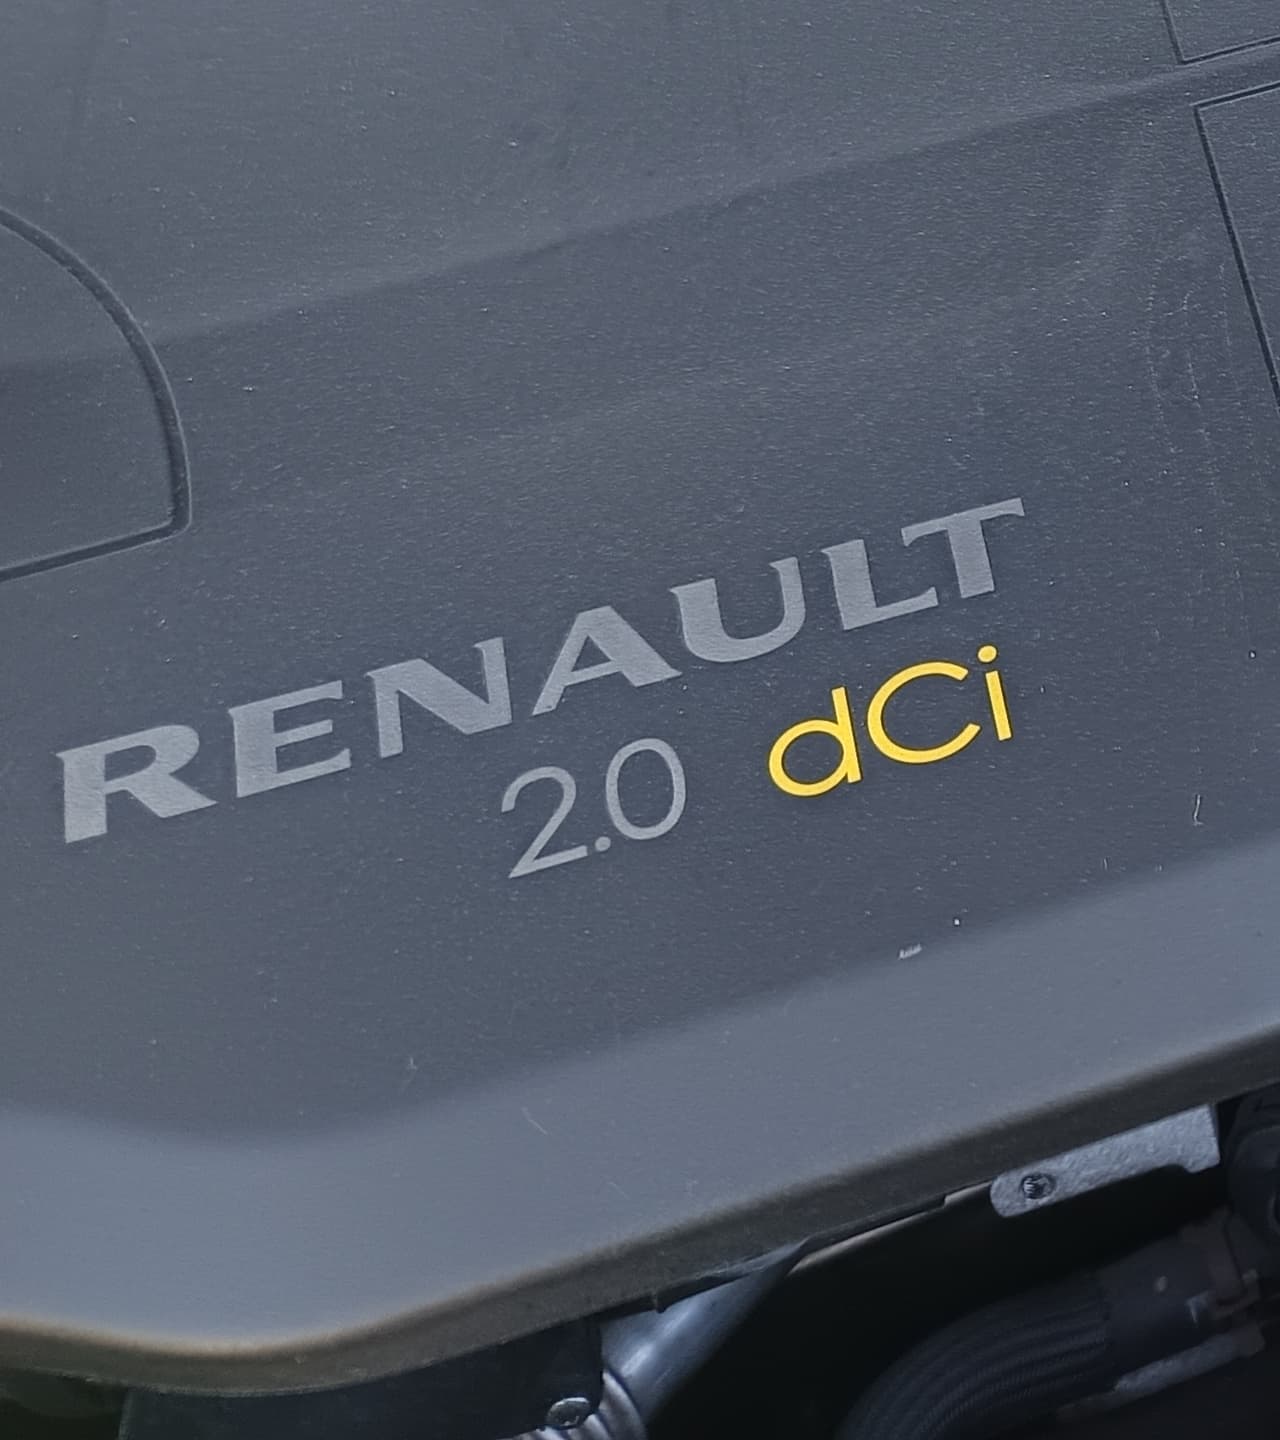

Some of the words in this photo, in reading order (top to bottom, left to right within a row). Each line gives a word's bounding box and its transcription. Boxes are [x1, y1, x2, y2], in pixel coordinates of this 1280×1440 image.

[55, 497, 1025, 845] RENAULT
[500, 737, 688, 879] 2.0
[768, 644, 1012, 797] dCi
